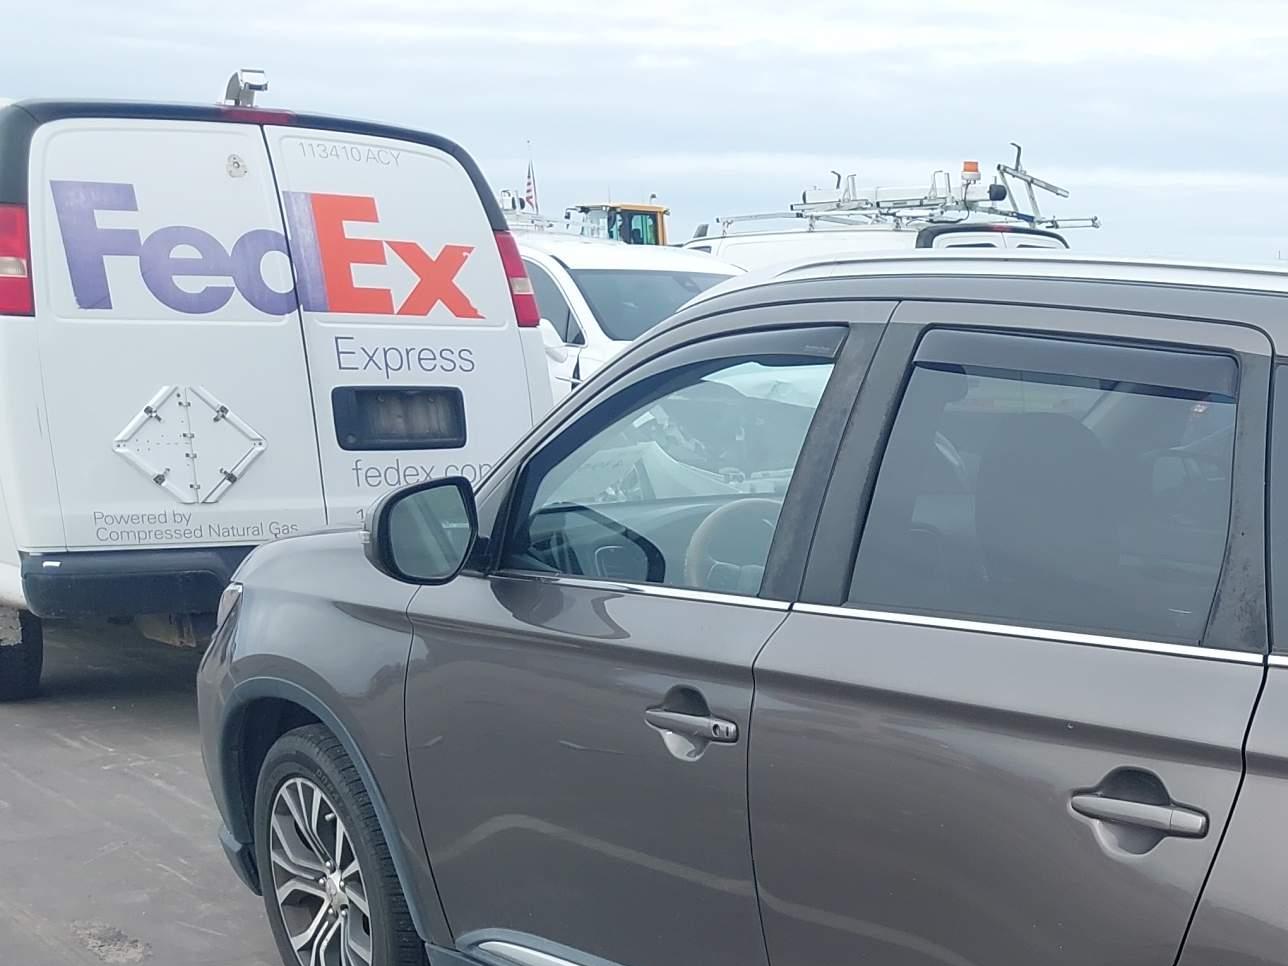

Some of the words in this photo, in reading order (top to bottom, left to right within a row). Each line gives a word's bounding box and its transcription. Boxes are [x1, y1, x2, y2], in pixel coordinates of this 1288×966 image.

[299, 142, 361, 162] 113410
[366, 148, 401, 166] ACY
[49, 180, 486, 319] FedEx
[334, 335, 476, 379] Express
[93, 511, 168, 526] Powered
[172, 511, 193, 526] by
[96, 525, 203, 543] Compressed
[208, 522, 264, 538] Natural
[268, 521, 299, 538] Gas
